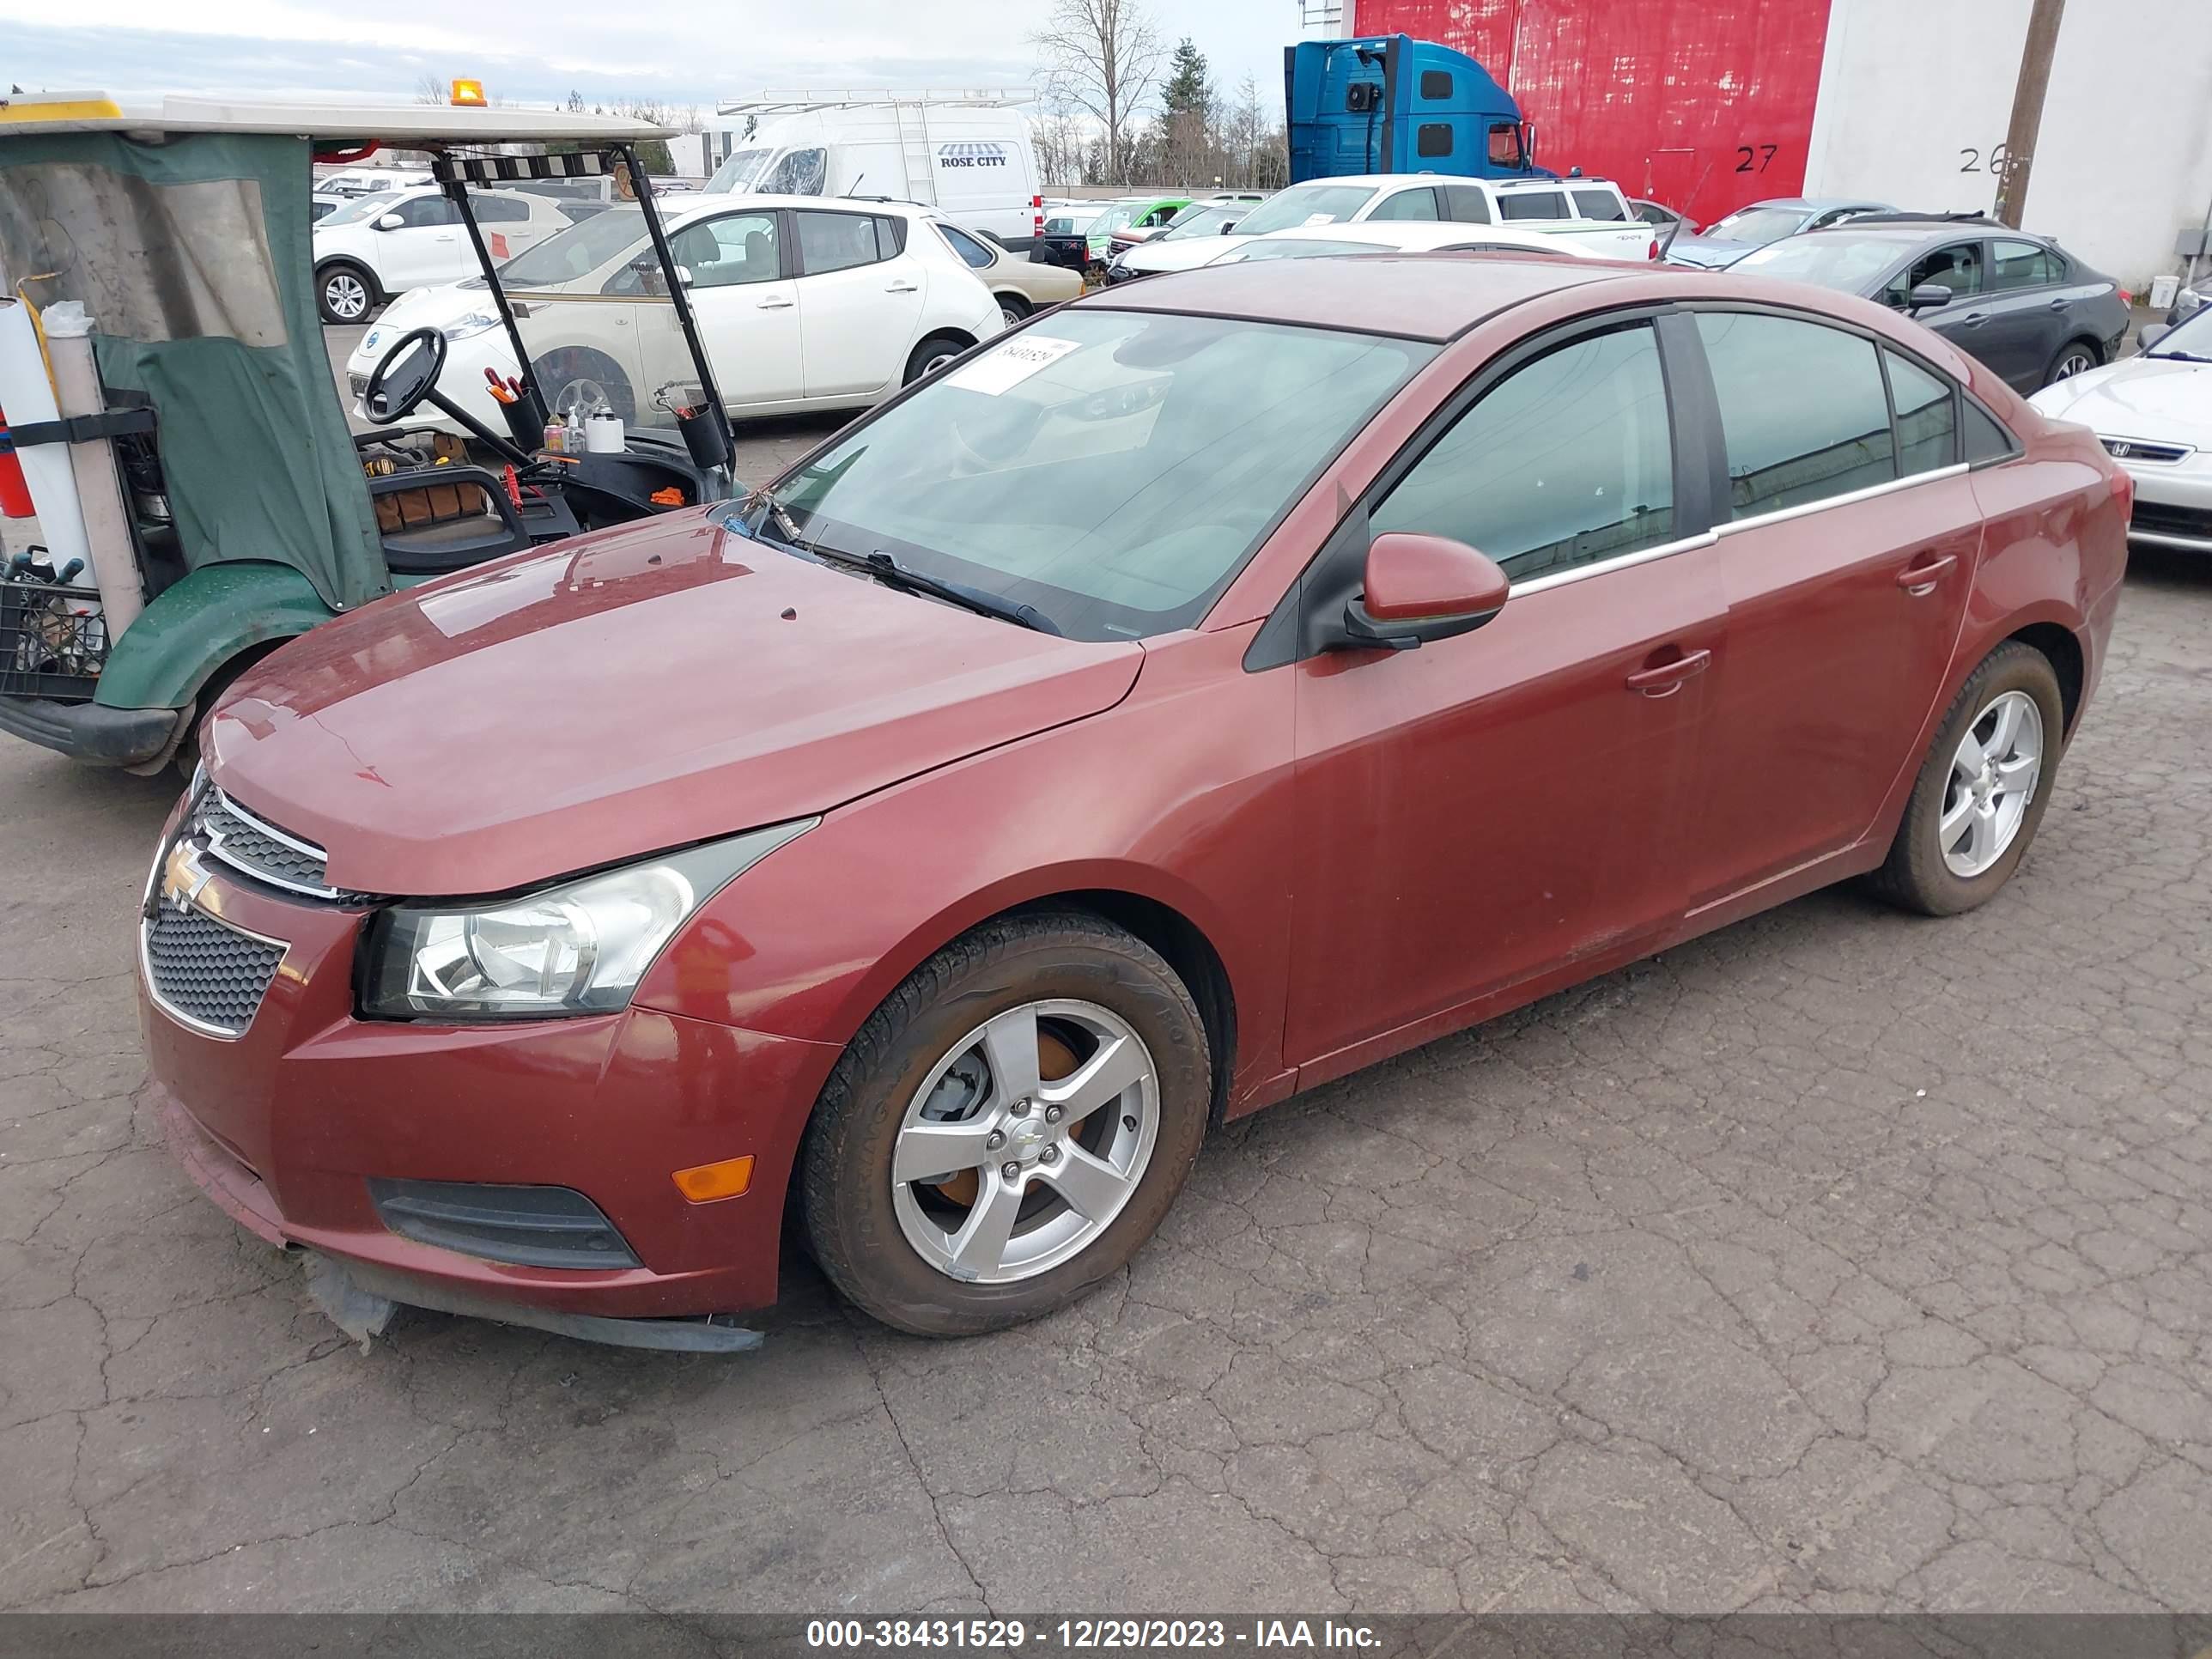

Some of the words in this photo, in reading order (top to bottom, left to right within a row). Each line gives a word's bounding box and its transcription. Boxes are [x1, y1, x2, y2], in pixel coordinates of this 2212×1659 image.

[940, 157, 975, 168] ROSE
[976, 156, 1006, 167] CITY
[1735, 144, 1778, 173] 27
[1960, 143, 2006, 174] 26
